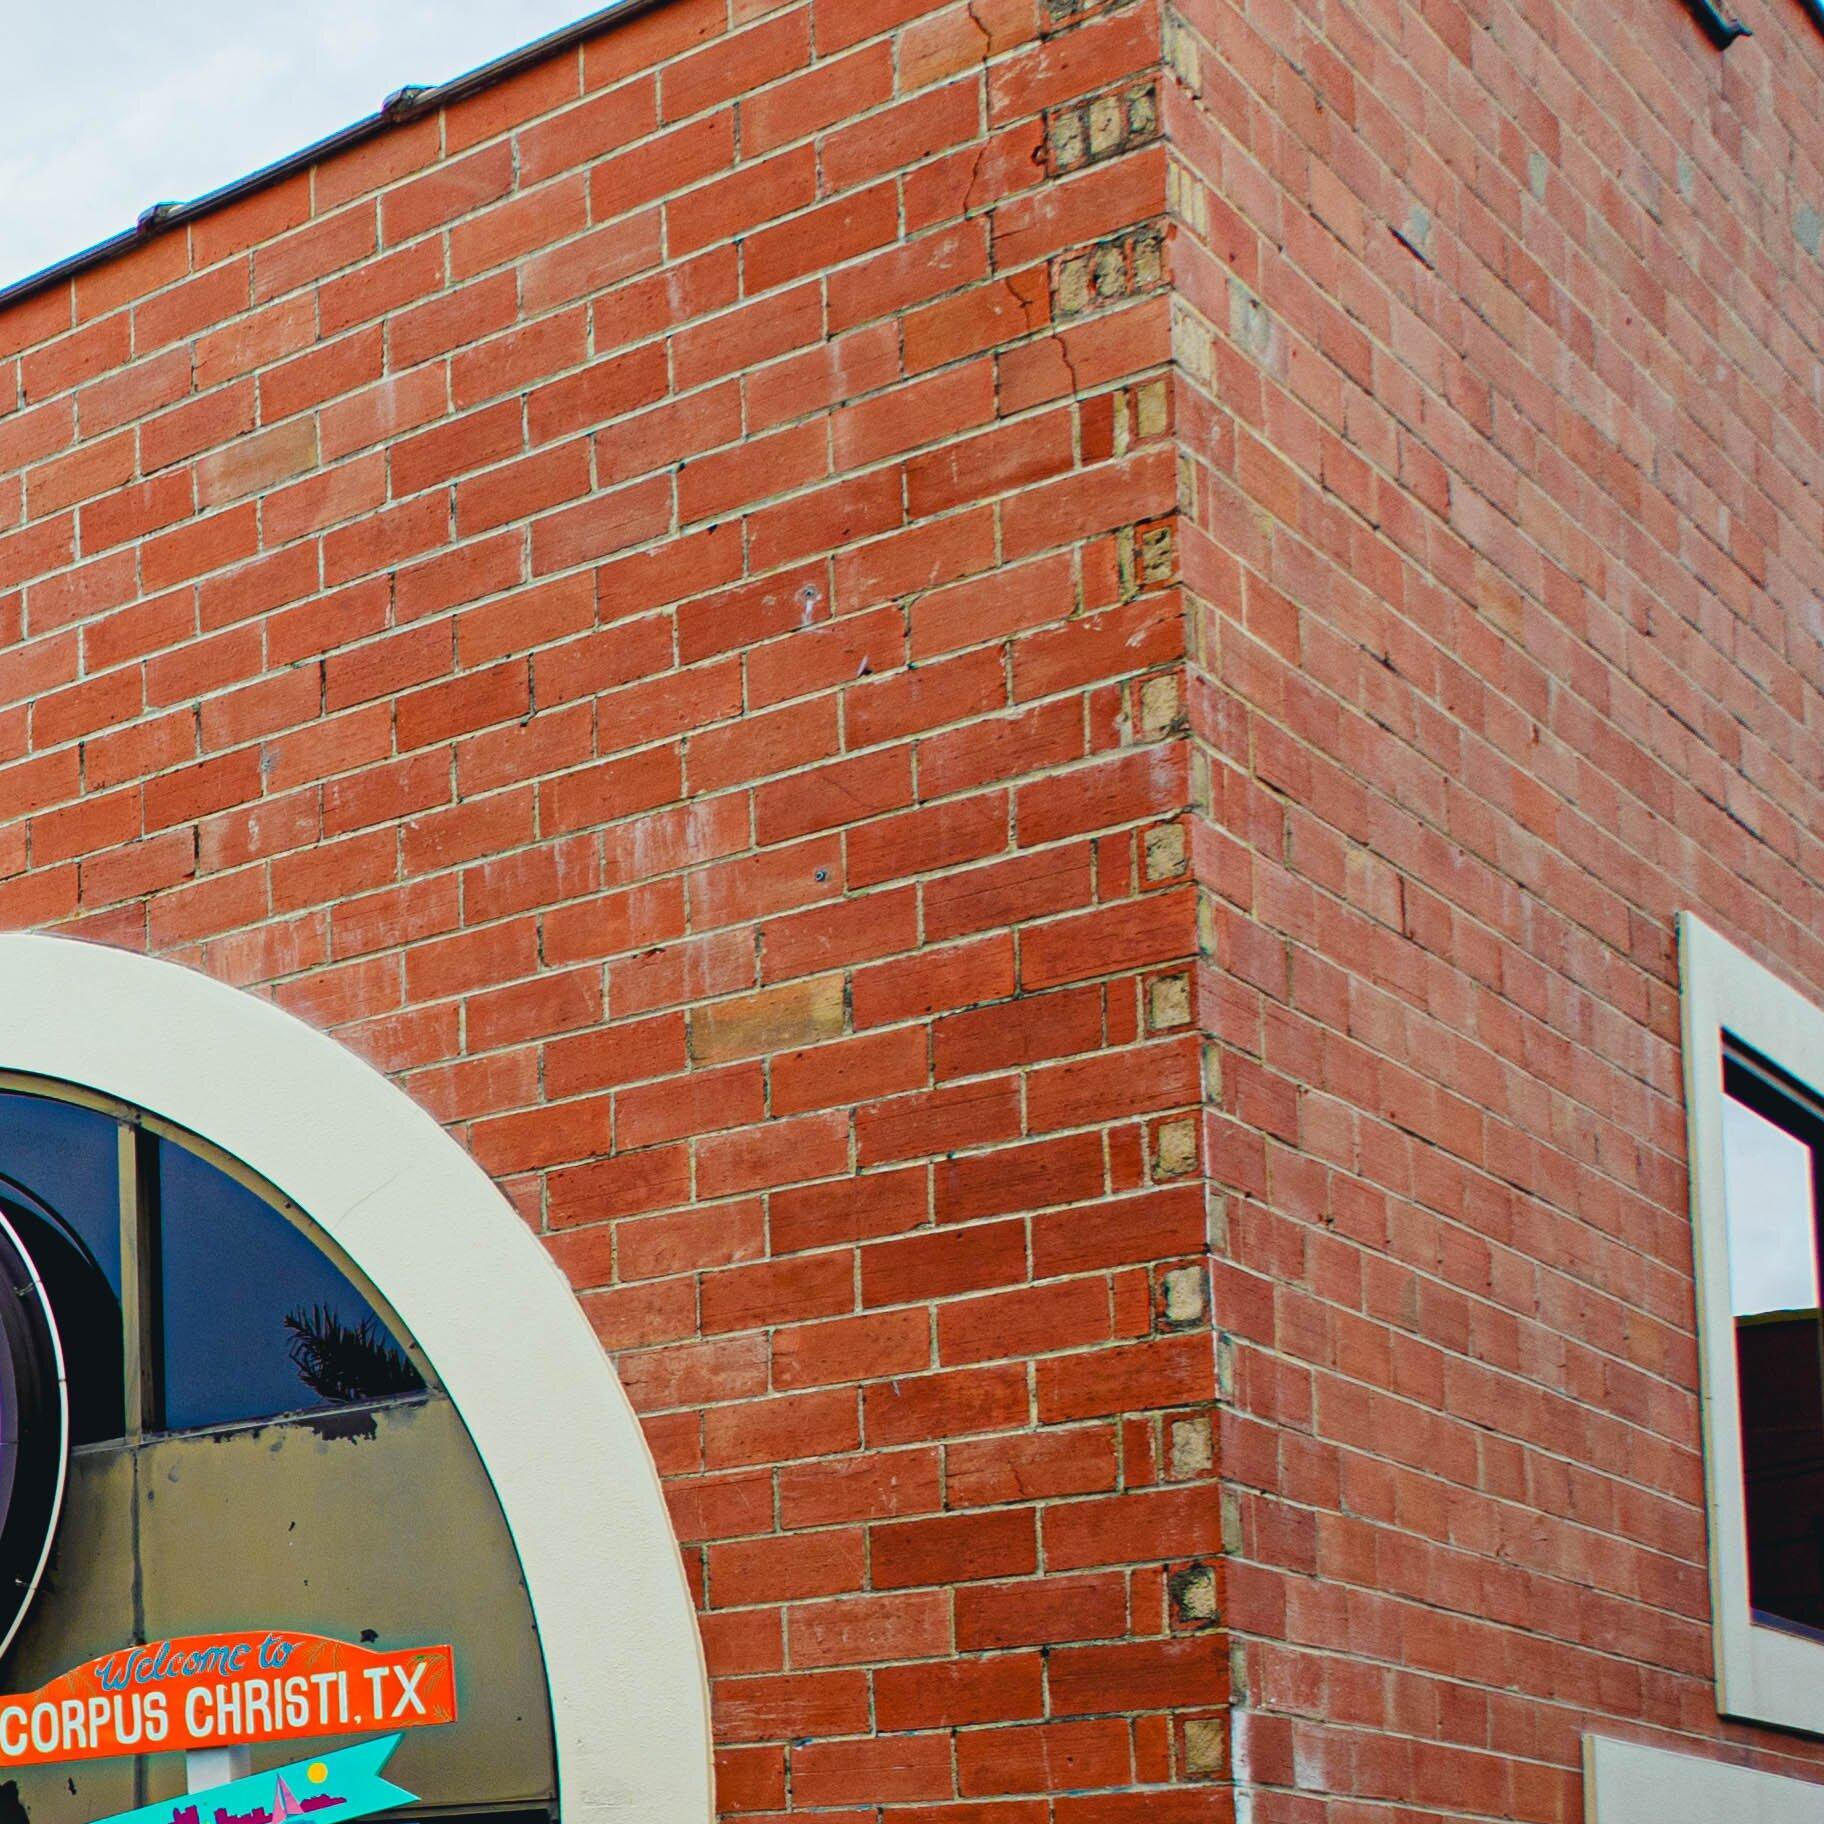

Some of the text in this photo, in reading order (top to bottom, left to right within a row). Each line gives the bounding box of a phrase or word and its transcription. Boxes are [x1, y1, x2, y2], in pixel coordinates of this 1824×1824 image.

[94, 1632, 305, 1692] Welcome to
[364, 1662, 428, 1721] TX
